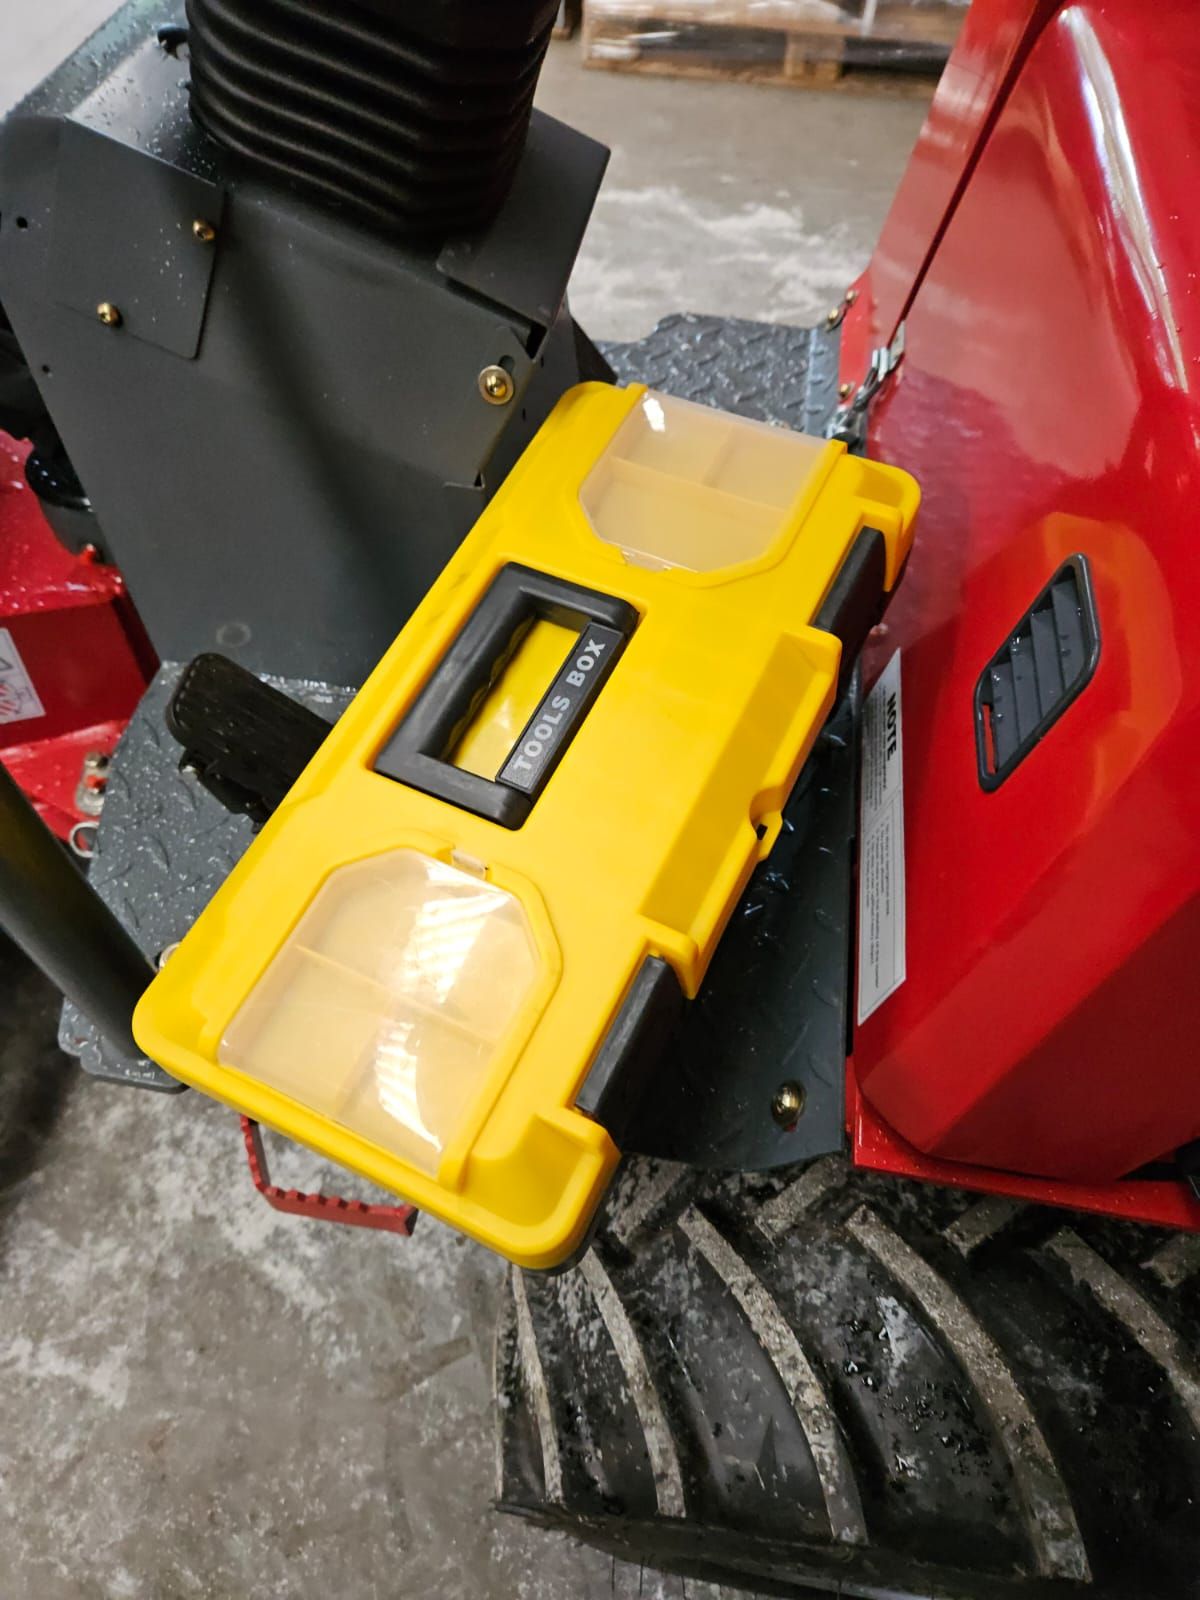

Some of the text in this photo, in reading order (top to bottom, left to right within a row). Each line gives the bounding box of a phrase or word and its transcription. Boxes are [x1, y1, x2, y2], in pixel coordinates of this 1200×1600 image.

[513, 639, 605, 770] TOOLS BOX
[887, 692, 897, 761] NOTE
